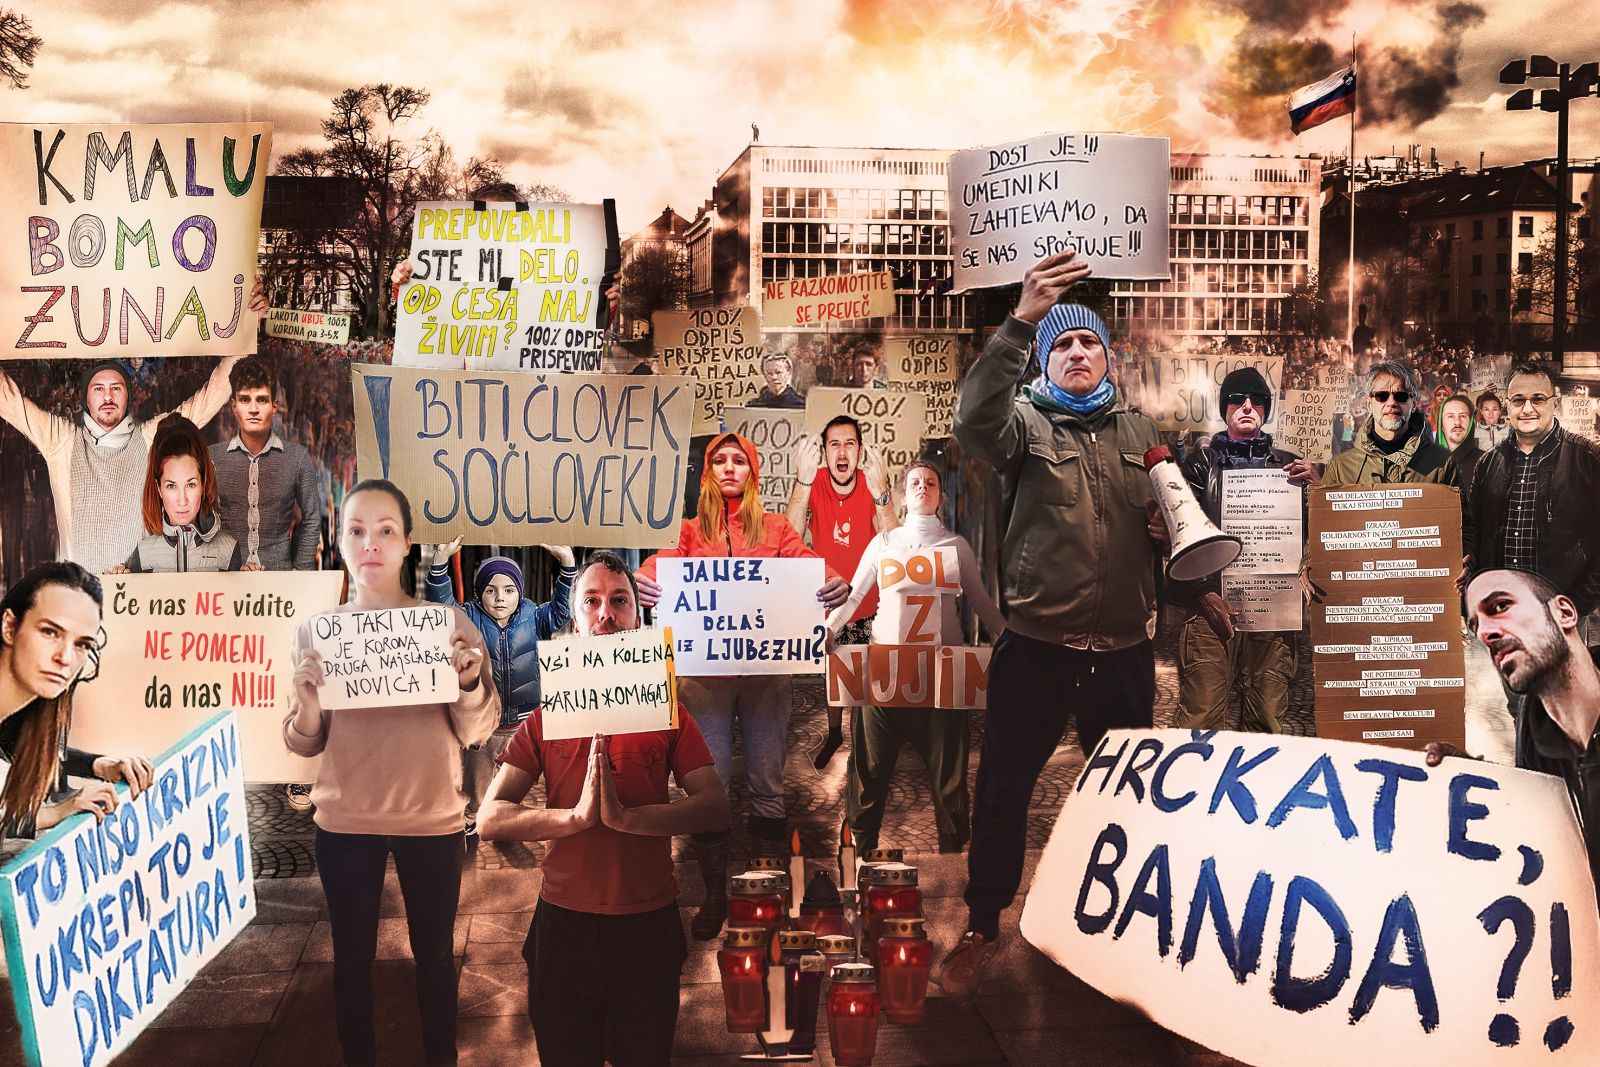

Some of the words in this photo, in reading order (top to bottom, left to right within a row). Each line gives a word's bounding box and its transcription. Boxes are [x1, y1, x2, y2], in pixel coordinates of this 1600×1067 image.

[33, 129, 261, 205] KMALU
[989, 144, 1028, 171] DOST
[963, 170, 1058, 207] UMETNIKI
[418, 208, 570, 244] PREPOVEDALI
[1124, 205, 1147, 224] DA
[28, 214, 217, 275] BOMO
[962, 248, 979, 268] SE
[988, 242, 1017, 265] NAS
[411, 249, 462, 281] STE
[479, 248, 502, 282] MI
[520, 249, 589, 284] DELO.
[767, 282, 785, 300] NE
[791, 272, 888, 298] RAZKOMOTITE
[403, 284, 442, 315] OD
[451, 282, 518, 320] ČESA
[539, 289, 591, 323] NAJ
[796, 305, 812, 323] SE
[818, 294, 870, 321] PREVEČ
[270, 311, 299, 322] LAKOTA
[301, 314, 324, 324] UBIJE
[327, 317, 346, 327] 100%
[689, 308, 741, 327] 100%
[273, 324, 305, 336] KORONA
[307, 329, 317, 339] pa
[525, 326, 561, 346] 100%
[565, 329, 604, 349] ODPIS
[519, 347, 603, 371] PRISPEVKOV
[665, 347, 763, 367] PRISPEVKOV
[908, 338, 952, 356] 100%
[902, 356, 948, 375] ODPIS
[696, 381, 757, 400] DJETJA
[1301, 393, 1327, 404] 100%
[523, 374, 680, 451] ČLOVEK
[842, 393, 906, 418] 100%
[1295, 406, 1323, 416] ODPIS
[1286, 415, 1333, 426] PRISPEVKOV
[1297, 427, 1307, 436] ZA
[1310, 428, 1331, 437] MALA
[1285, 435, 1319, 448] PODJETJA
[423, 442, 681, 529] SOČLOVEKU
[1322, 531, 1370, 540] SOLIDARNOST
[1381, 528, 1431, 537] POVEZOVANJE
[683, 559, 771, 585] JANEZ,
[881, 551, 960, 590] DOL
[1385, 570, 1418, 578] VSILJENE
[112, 582, 140, 616] Če
[149, 596, 187, 617] nas
[195, 591, 225, 618] NE
[232, 594, 296, 619] vidite
[673, 589, 718, 613] ALI
[316, 615, 342, 640] OB
[352, 611, 393, 633] TAKI
[401, 606, 448, 631] VLADI
[703, 608, 766, 632] DELAŠ
[905, 596, 935, 643] Z
[144, 629, 173, 661] NE
[180, 632, 273, 672] POMENI,
[364, 636, 419, 655] KORONA
[583, 650, 604, 668] NA
[613, 644, 675, 664] KOLENA
[677, 639, 694, 653] IZ
[1372, 644, 1412, 652] RASISTIČNI
[323, 659, 372, 677] DRUGA
[1375, 670, 1420, 678] POTREBUJEM
[144, 675, 172, 709] da
[182, 680, 222, 709] nas
[231, 671, 276, 709] NI!!!
[1075, 730, 1545, 888] HRČKATE,
[15, 846, 68, 929] TO
[75, 802, 140, 894] NISO
[144, 724, 237, 841] KRIZNI
[148, 831, 192, 904] TO
[203, 792, 232, 861] JE
